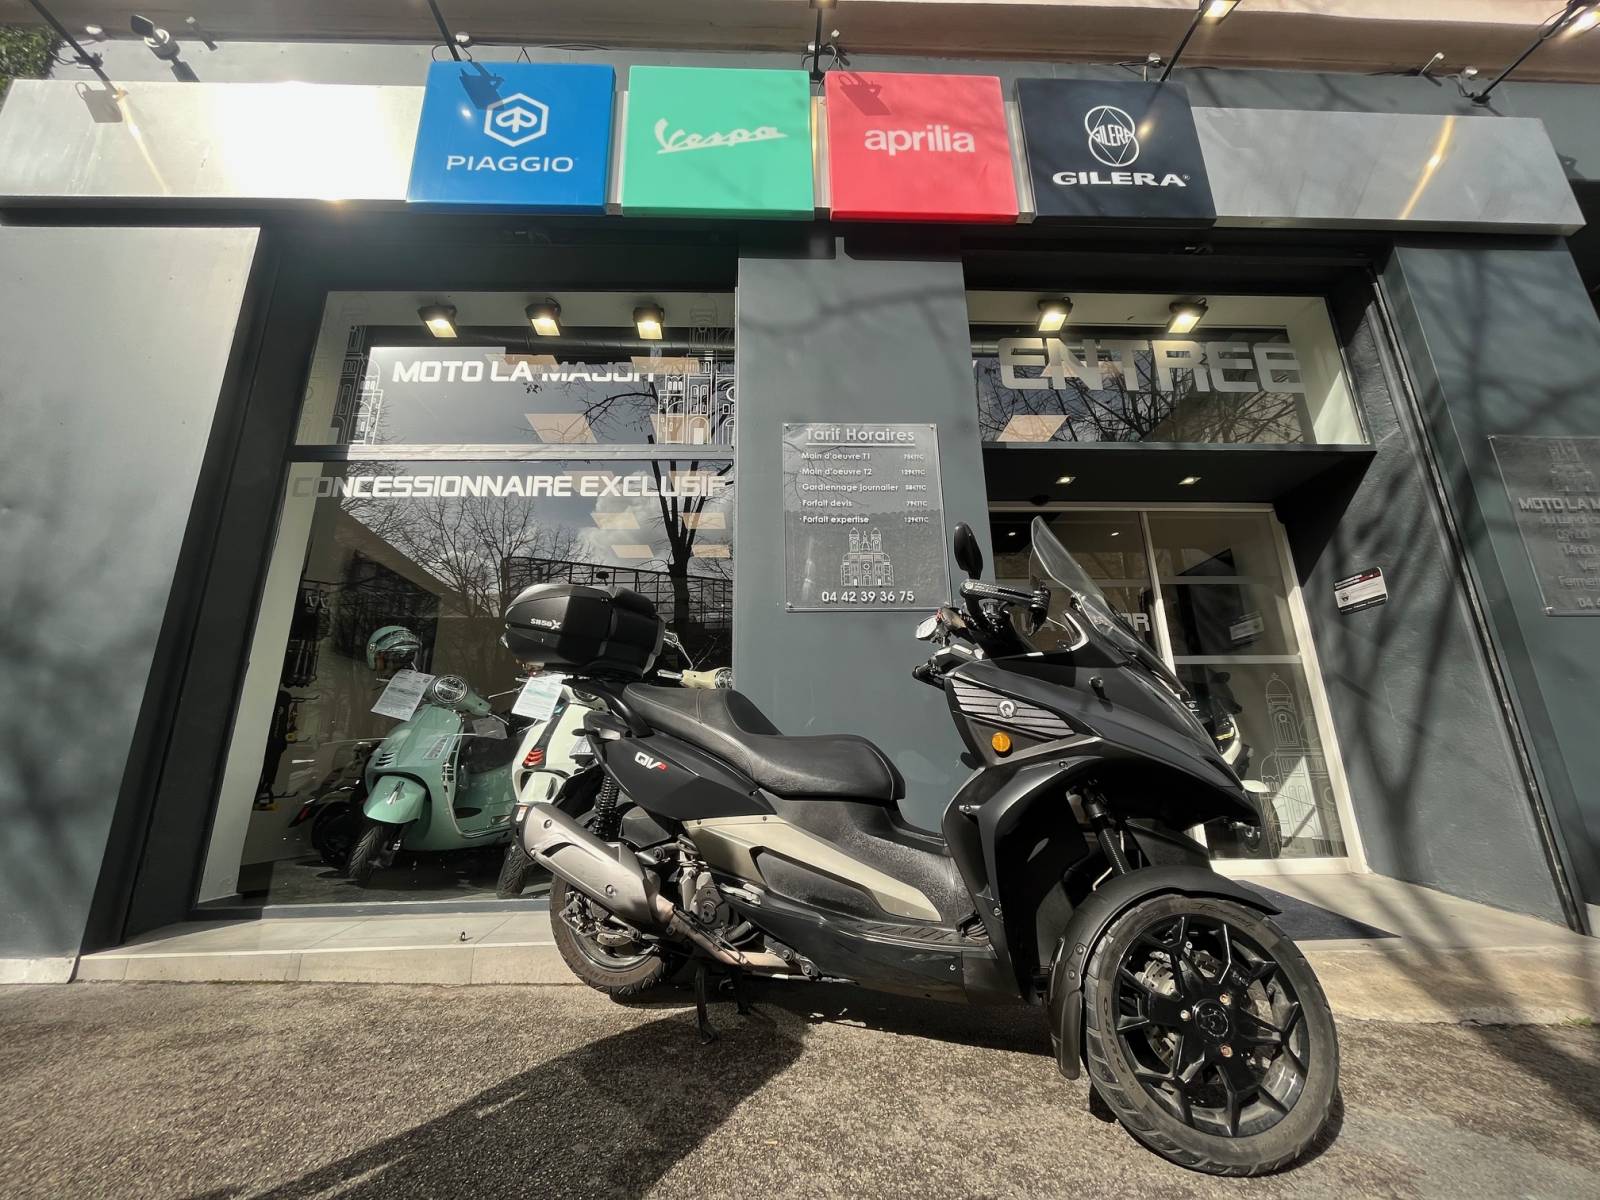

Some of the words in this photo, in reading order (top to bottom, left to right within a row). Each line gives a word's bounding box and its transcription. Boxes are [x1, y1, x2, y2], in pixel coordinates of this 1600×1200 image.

[654, 118, 788, 155] Vespa
[864, 124, 975, 157] aprilia
[1090, 124, 1134, 147] GILERA
[446, 155, 574, 173] PIAGGIO
[392, 360, 483, 383] MOTO
[490, 360, 533, 383] LA
[999, 337, 1305, 393] ENTREE
[805, 427, 841, 441] Tarif
[846, 427, 915, 441] Horaires
[801, 452, 822, 460] Main
[824, 452, 861, 460] d'oeuvre
[802, 467, 822, 475] Main
[824, 467, 862, 475] d'oeuvre
[293, 475, 573, 498] CONCESSIONNAIRE
[578, 475, 726, 498] EXCLUSIF
[802, 483, 858, 492] Gardiennage
[859, 483, 899, 492] journalier
[802, 499, 828, 507] Forfait
[830, 499, 853, 507] devis
[1518, 496, 1564, 510] MOTO
[1565, 496, 1590, 510] LA
[803, 515, 829, 523] Forfait
[830, 515, 870, 525] expertise
[821, 590, 838, 602] 04
[841, 590, 857, 602] 42
[860, 590, 876, 602] 39
[879, 590, 896, 602] 36
[899, 590, 915, 602] 75
